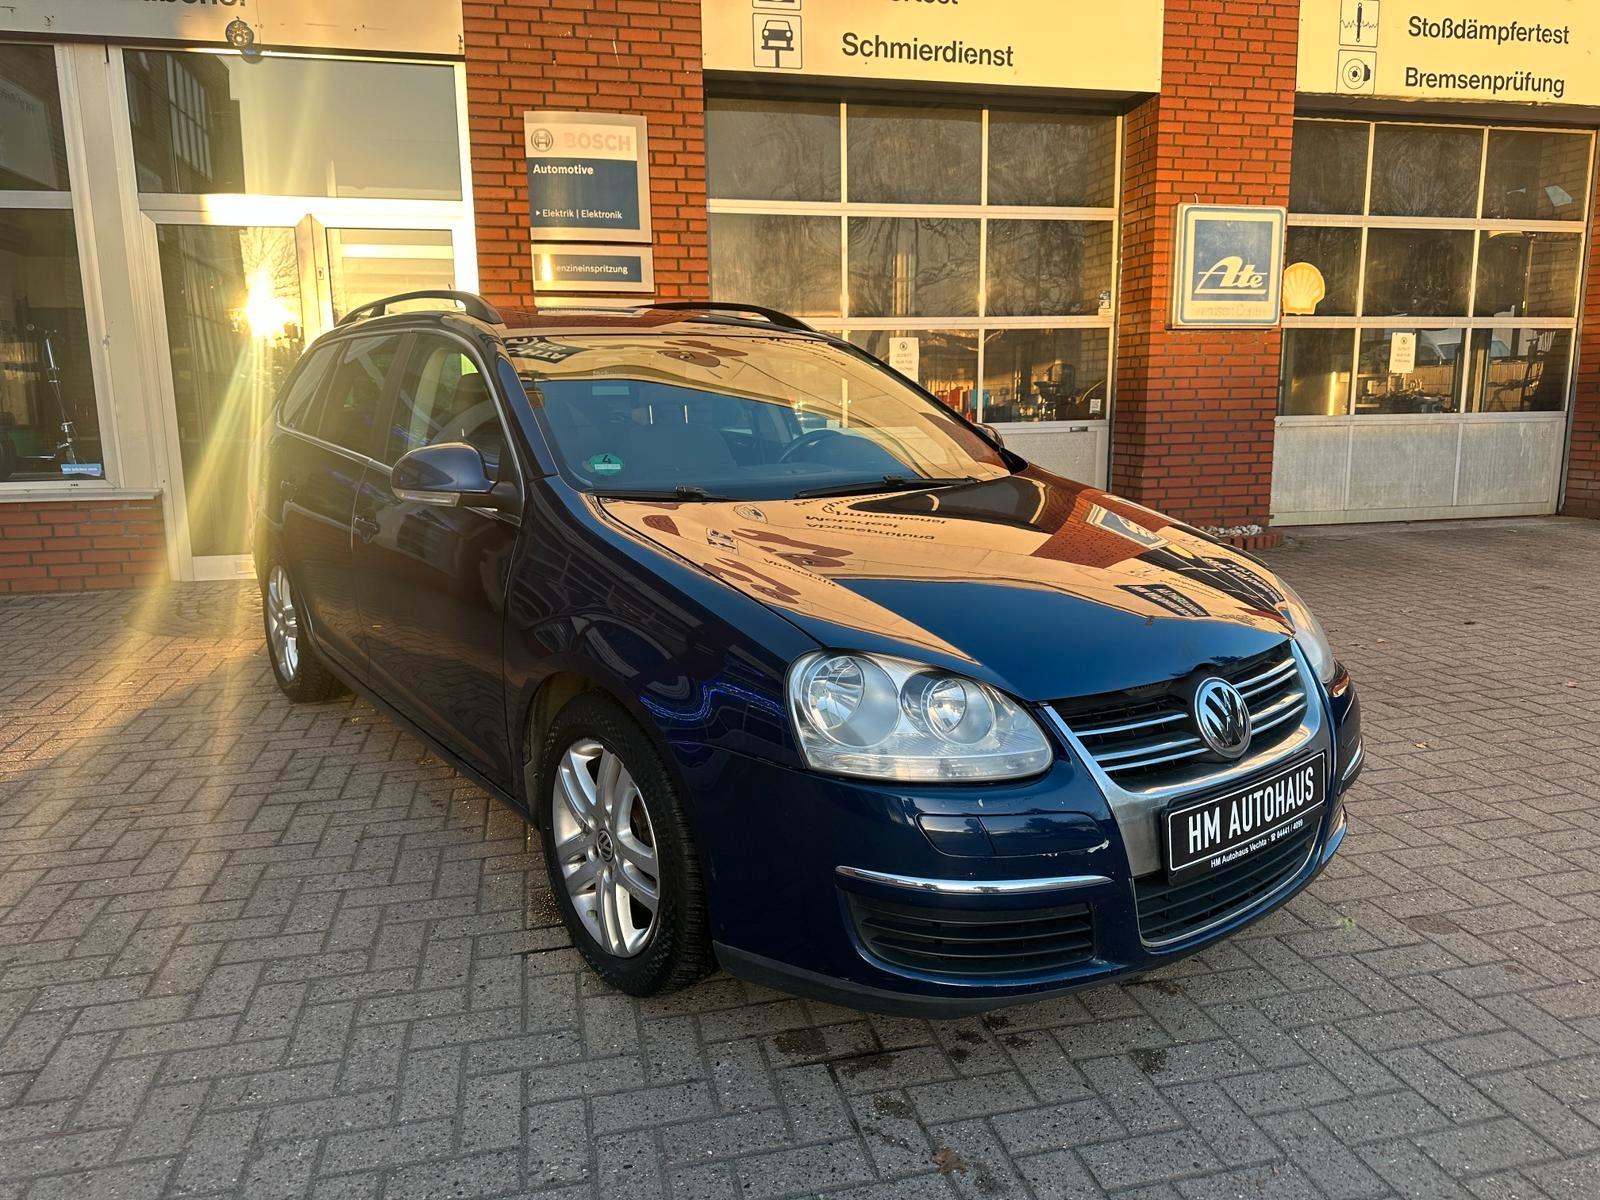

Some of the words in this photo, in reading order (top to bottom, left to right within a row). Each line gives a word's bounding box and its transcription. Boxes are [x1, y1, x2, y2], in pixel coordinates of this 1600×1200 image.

[1408, 16, 1569, 45] Stoßdämpfertest
[842, 32, 1014, 67] Schmierdienst
[1405, 67, 1565, 98] Bremsenprüfung
[563, 132, 632, 151] BOSCH
[533, 164, 594, 175] Automotive
[542, 209, 574, 218] Elektrik
[581, 209, 623, 219] Elektronik
[552, 263, 628, 275] enzineinspritzung
[1195, 256, 1268, 294] Ate
[1188, 806, 1221, 854] HM
[1228, 766, 1315, 840] AUTOHAUS
[1210, 857, 1222, 868] HM
[1221, 847, 1249, 864] Autohaus
